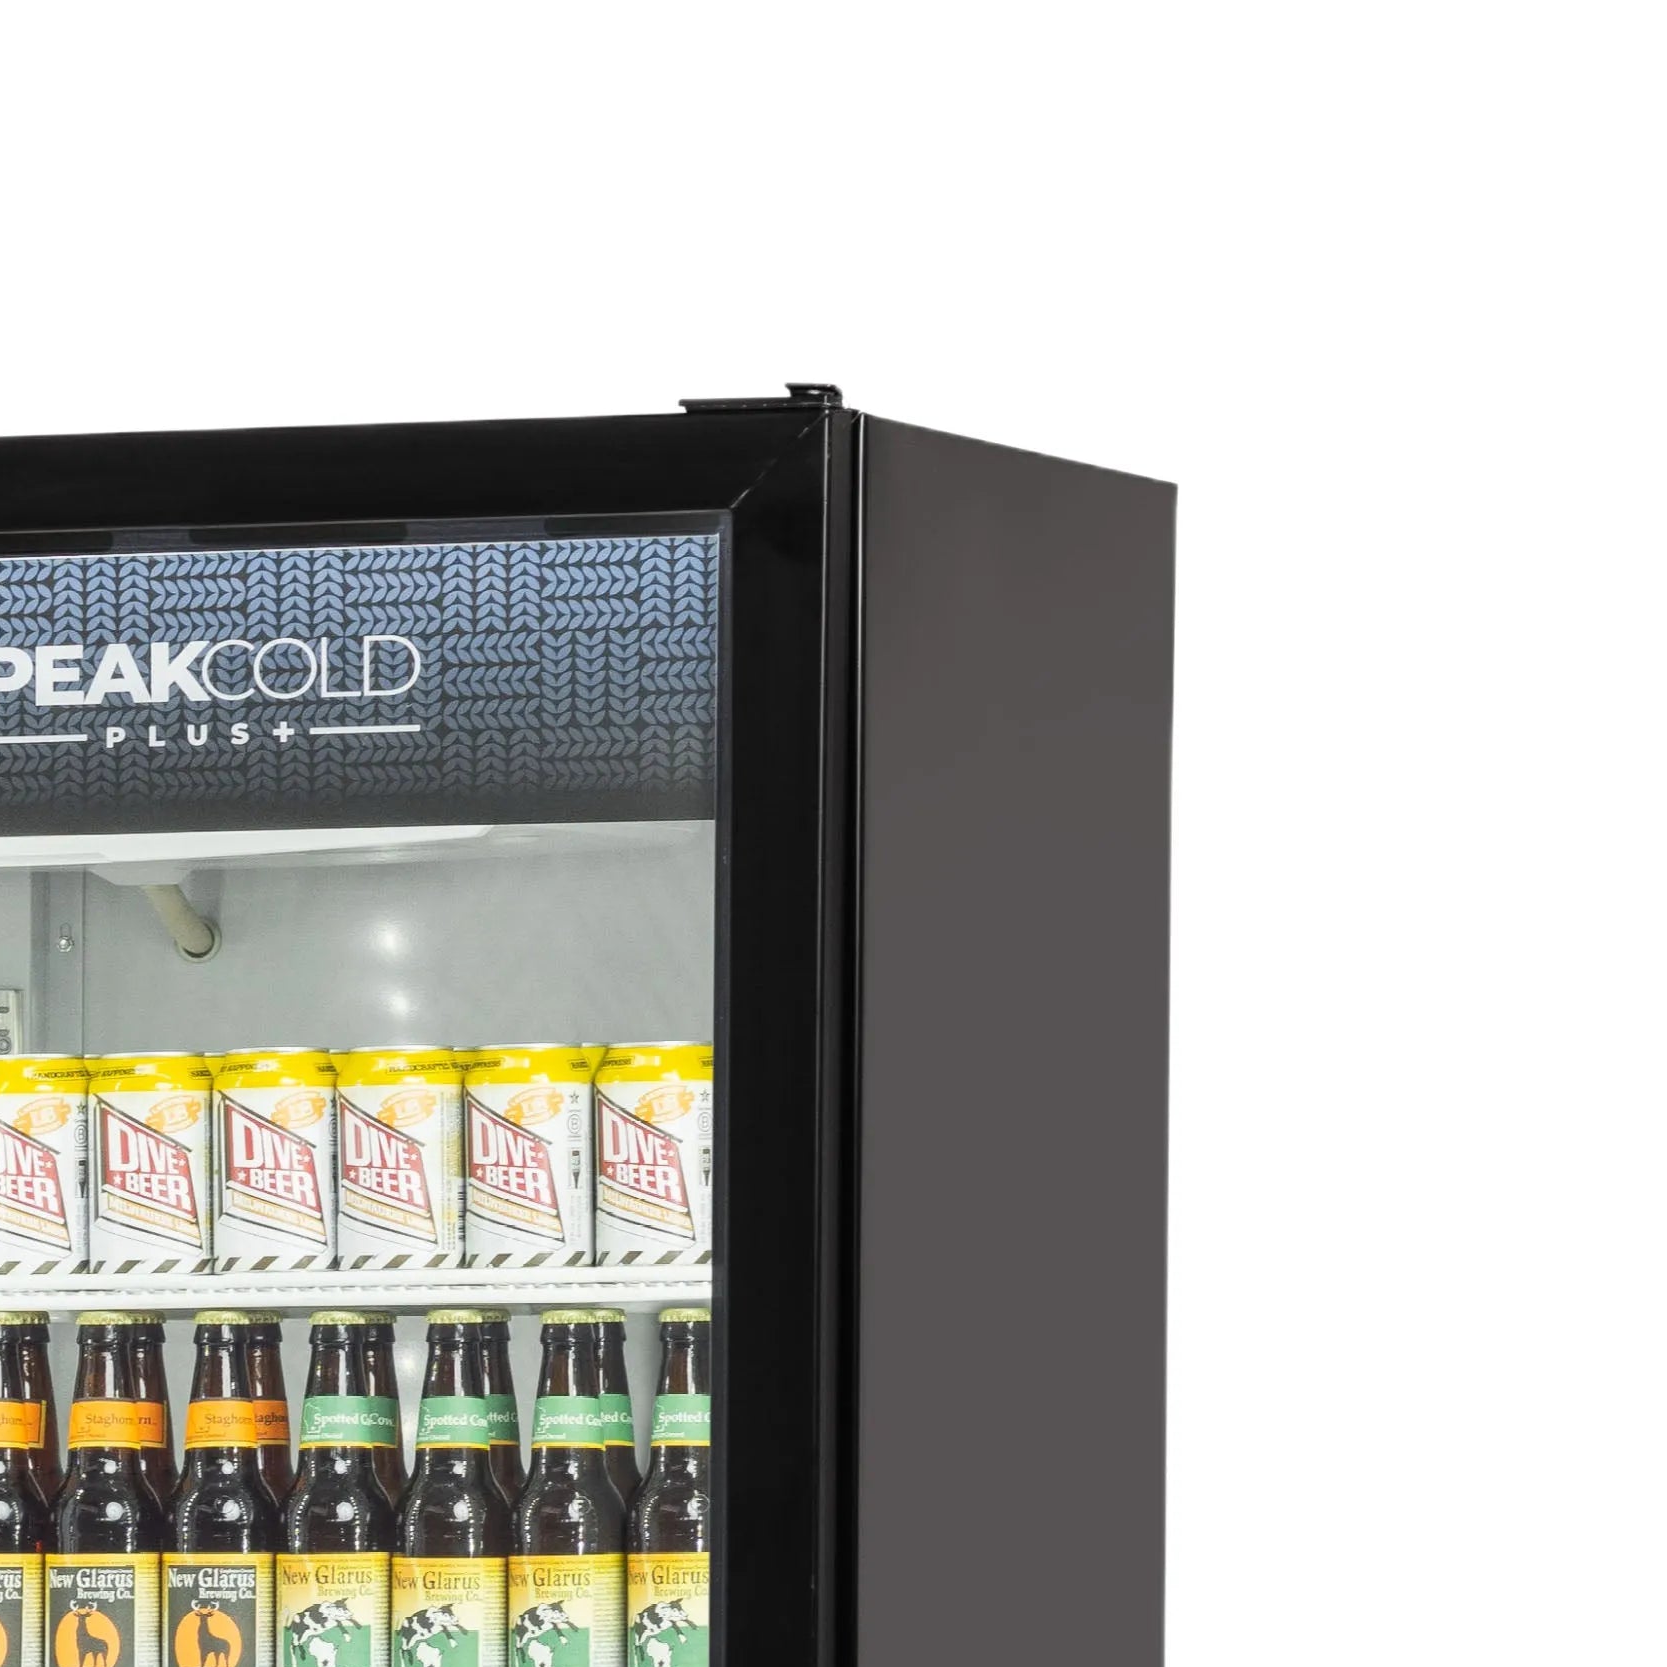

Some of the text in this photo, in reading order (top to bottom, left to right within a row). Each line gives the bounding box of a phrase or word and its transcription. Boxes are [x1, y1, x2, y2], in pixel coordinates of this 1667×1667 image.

[107, 1123, 180, 1174] DIVE
[231, 1116, 305, 1169] DIVE
[474, 1115, 539, 1167] DIVE
[125, 1174, 191, 1212] BEER
[249, 1167, 316, 1207] BEER
[485, 1166, 552, 1205] BEER
[314, 1412, 359, 1428] Spotted
[315, 1565, 372, 1585] Glarus
[533, 1567, 591, 1586] Glarus
